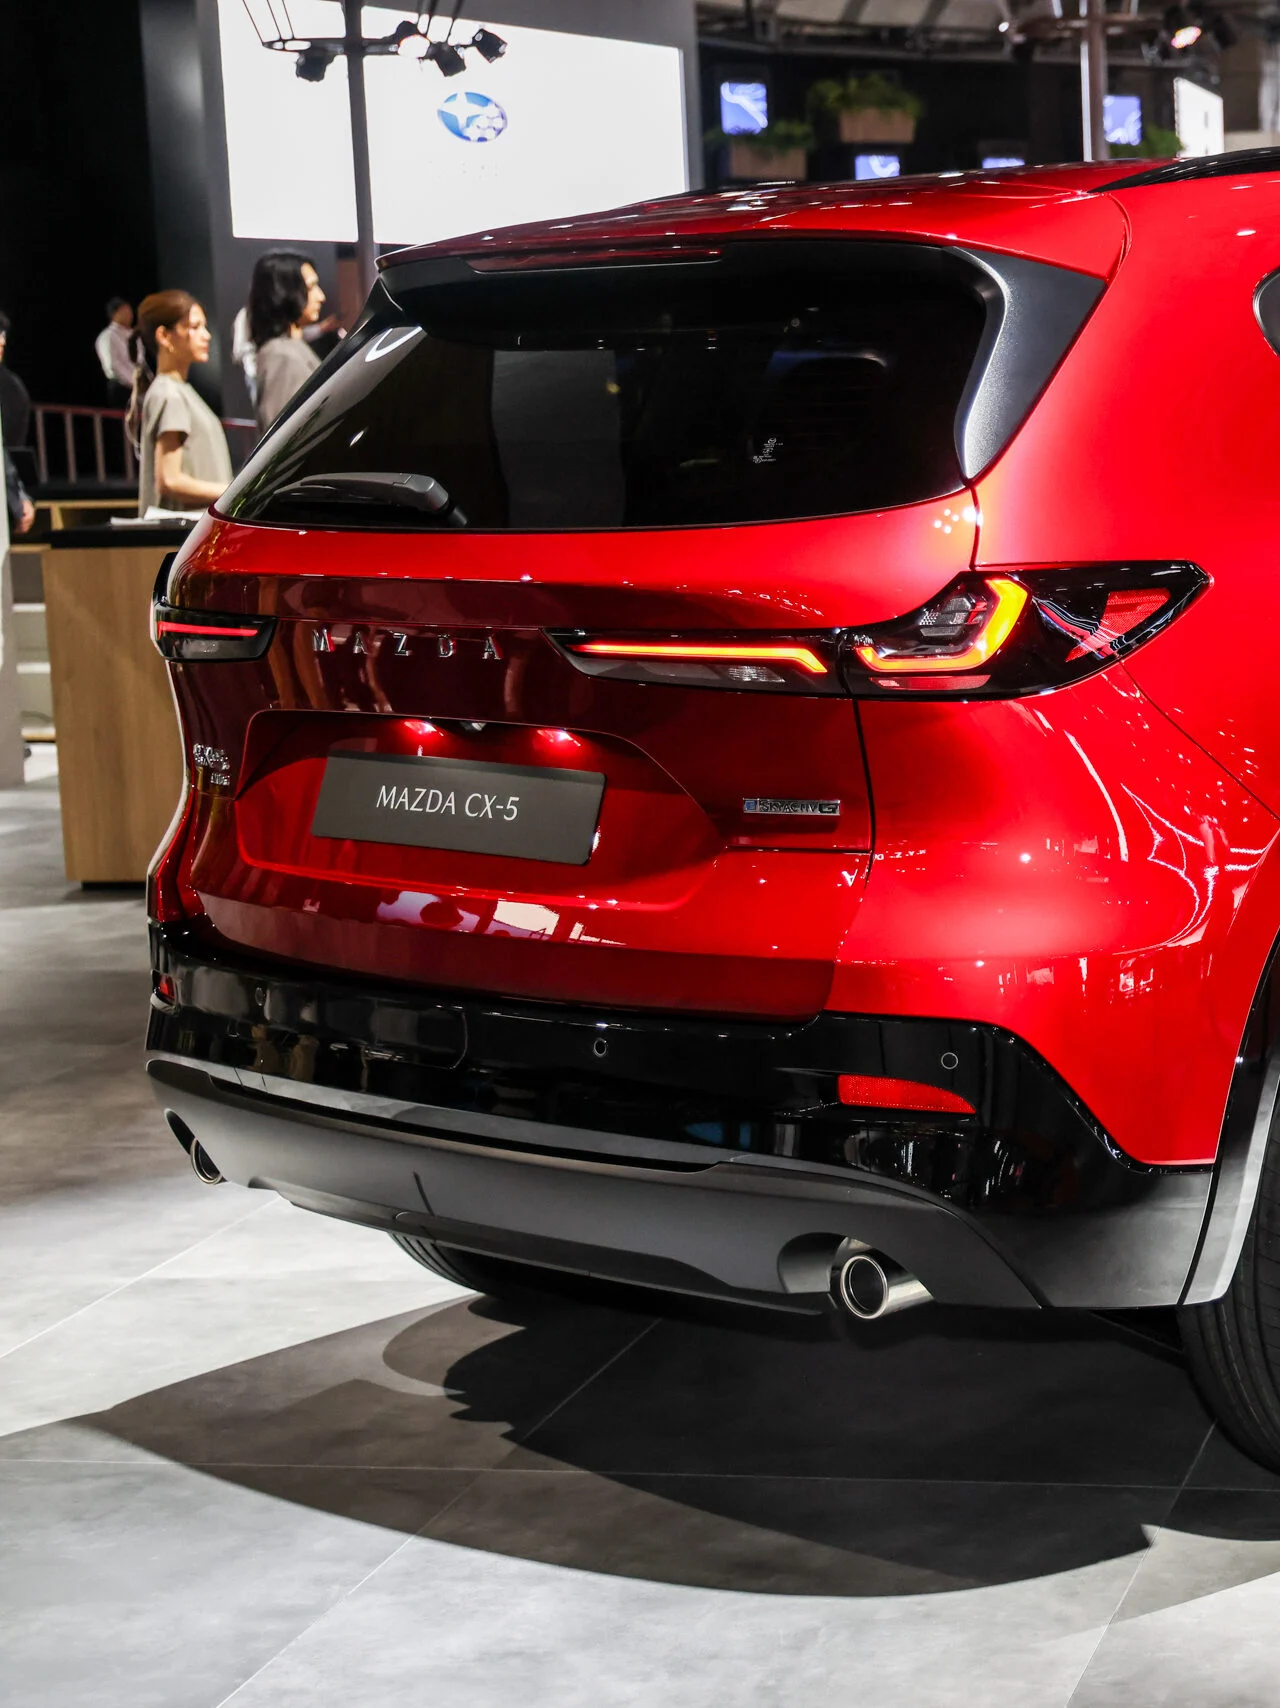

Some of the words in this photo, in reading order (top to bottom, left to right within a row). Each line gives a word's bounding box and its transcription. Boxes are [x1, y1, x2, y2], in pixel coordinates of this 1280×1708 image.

[313, 628, 502, 660] MAZDA
[376, 784, 456, 815] MAZDA
[464, 792, 520, 821] CX-5
